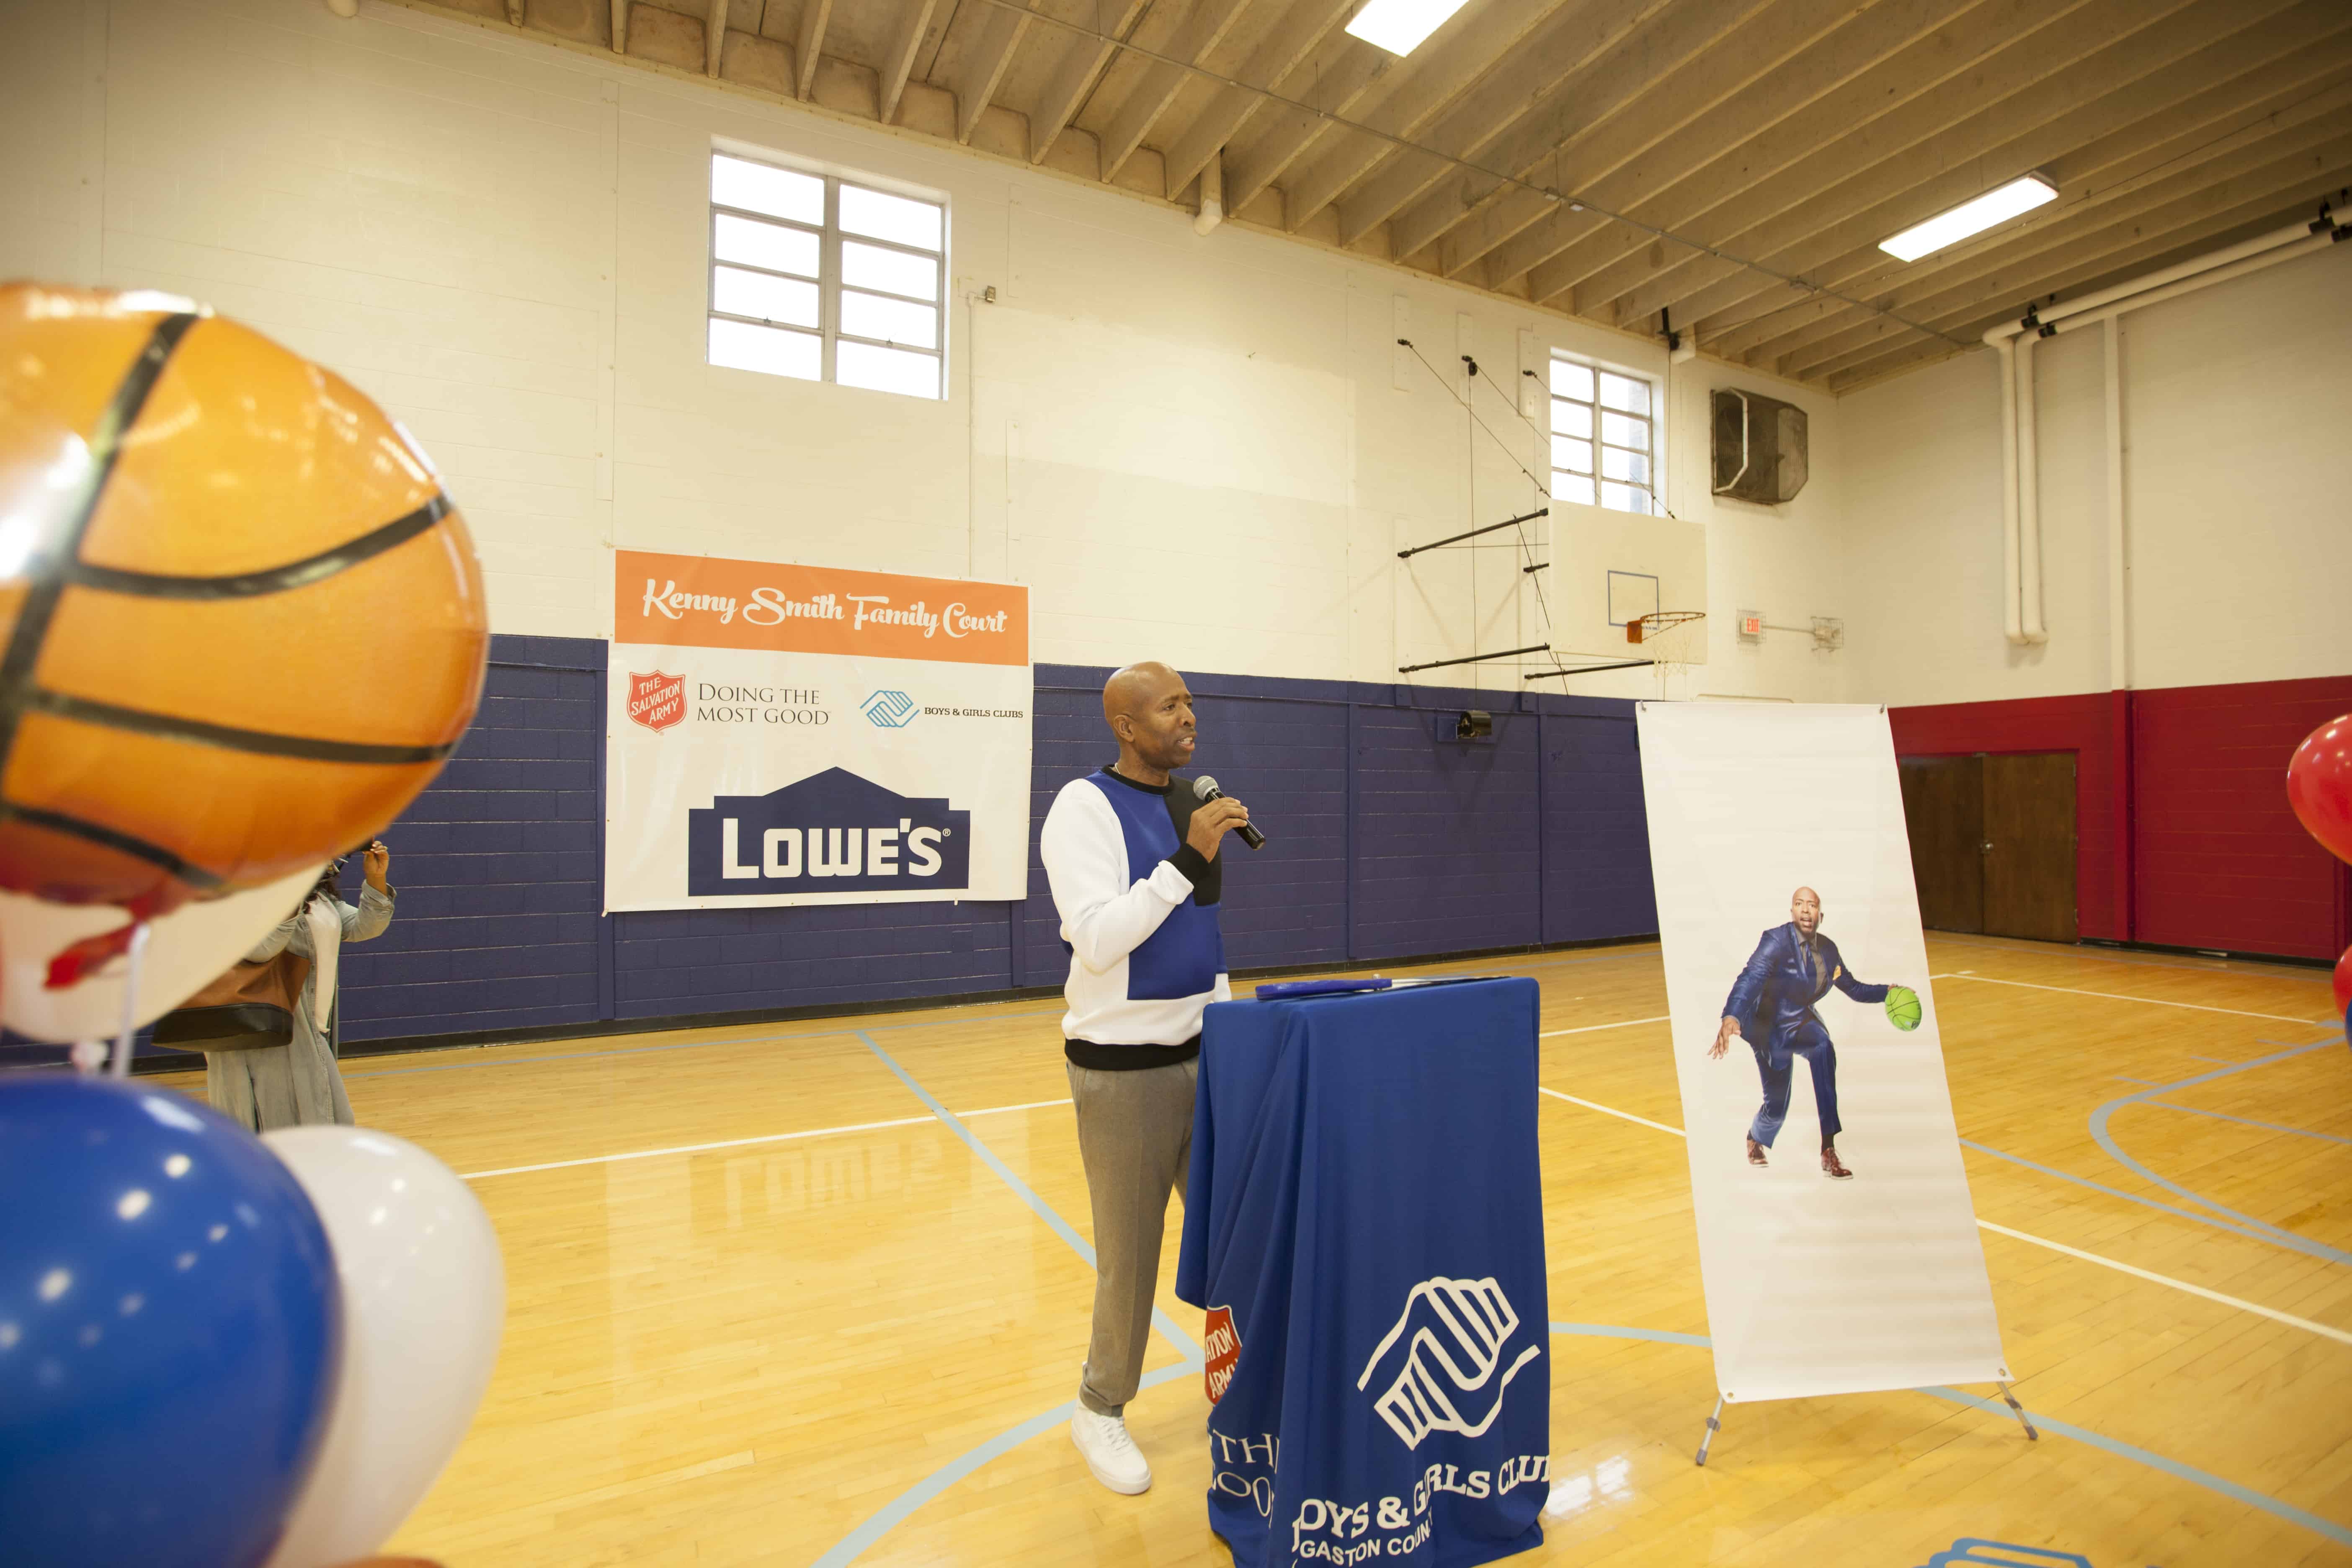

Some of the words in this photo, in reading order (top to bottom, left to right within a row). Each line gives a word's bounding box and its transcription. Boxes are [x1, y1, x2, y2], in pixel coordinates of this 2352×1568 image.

[643, 579, 738, 624] Kenny
[743, 587, 845, 625] Smith
[846, 593, 940, 638] Family
[943, 603, 1008, 638] Court
[1747, 618, 1759, 632] EXIT
[631, 680, 680, 716] SALVATION
[639, 677, 661, 695] THE
[699, 683, 774, 703] DOING
[780, 689, 820, 704] THE
[649, 697, 678, 724] ARMY
[697, 707, 758, 722] MOST
[764, 709, 829, 725] GOOD
[924, 707, 950, 715] BOYS
[963, 709, 990, 717] GIRLS
[1377, 1496, 1410, 1529] &
[1300, 1539, 1380, 1567] GASTON
